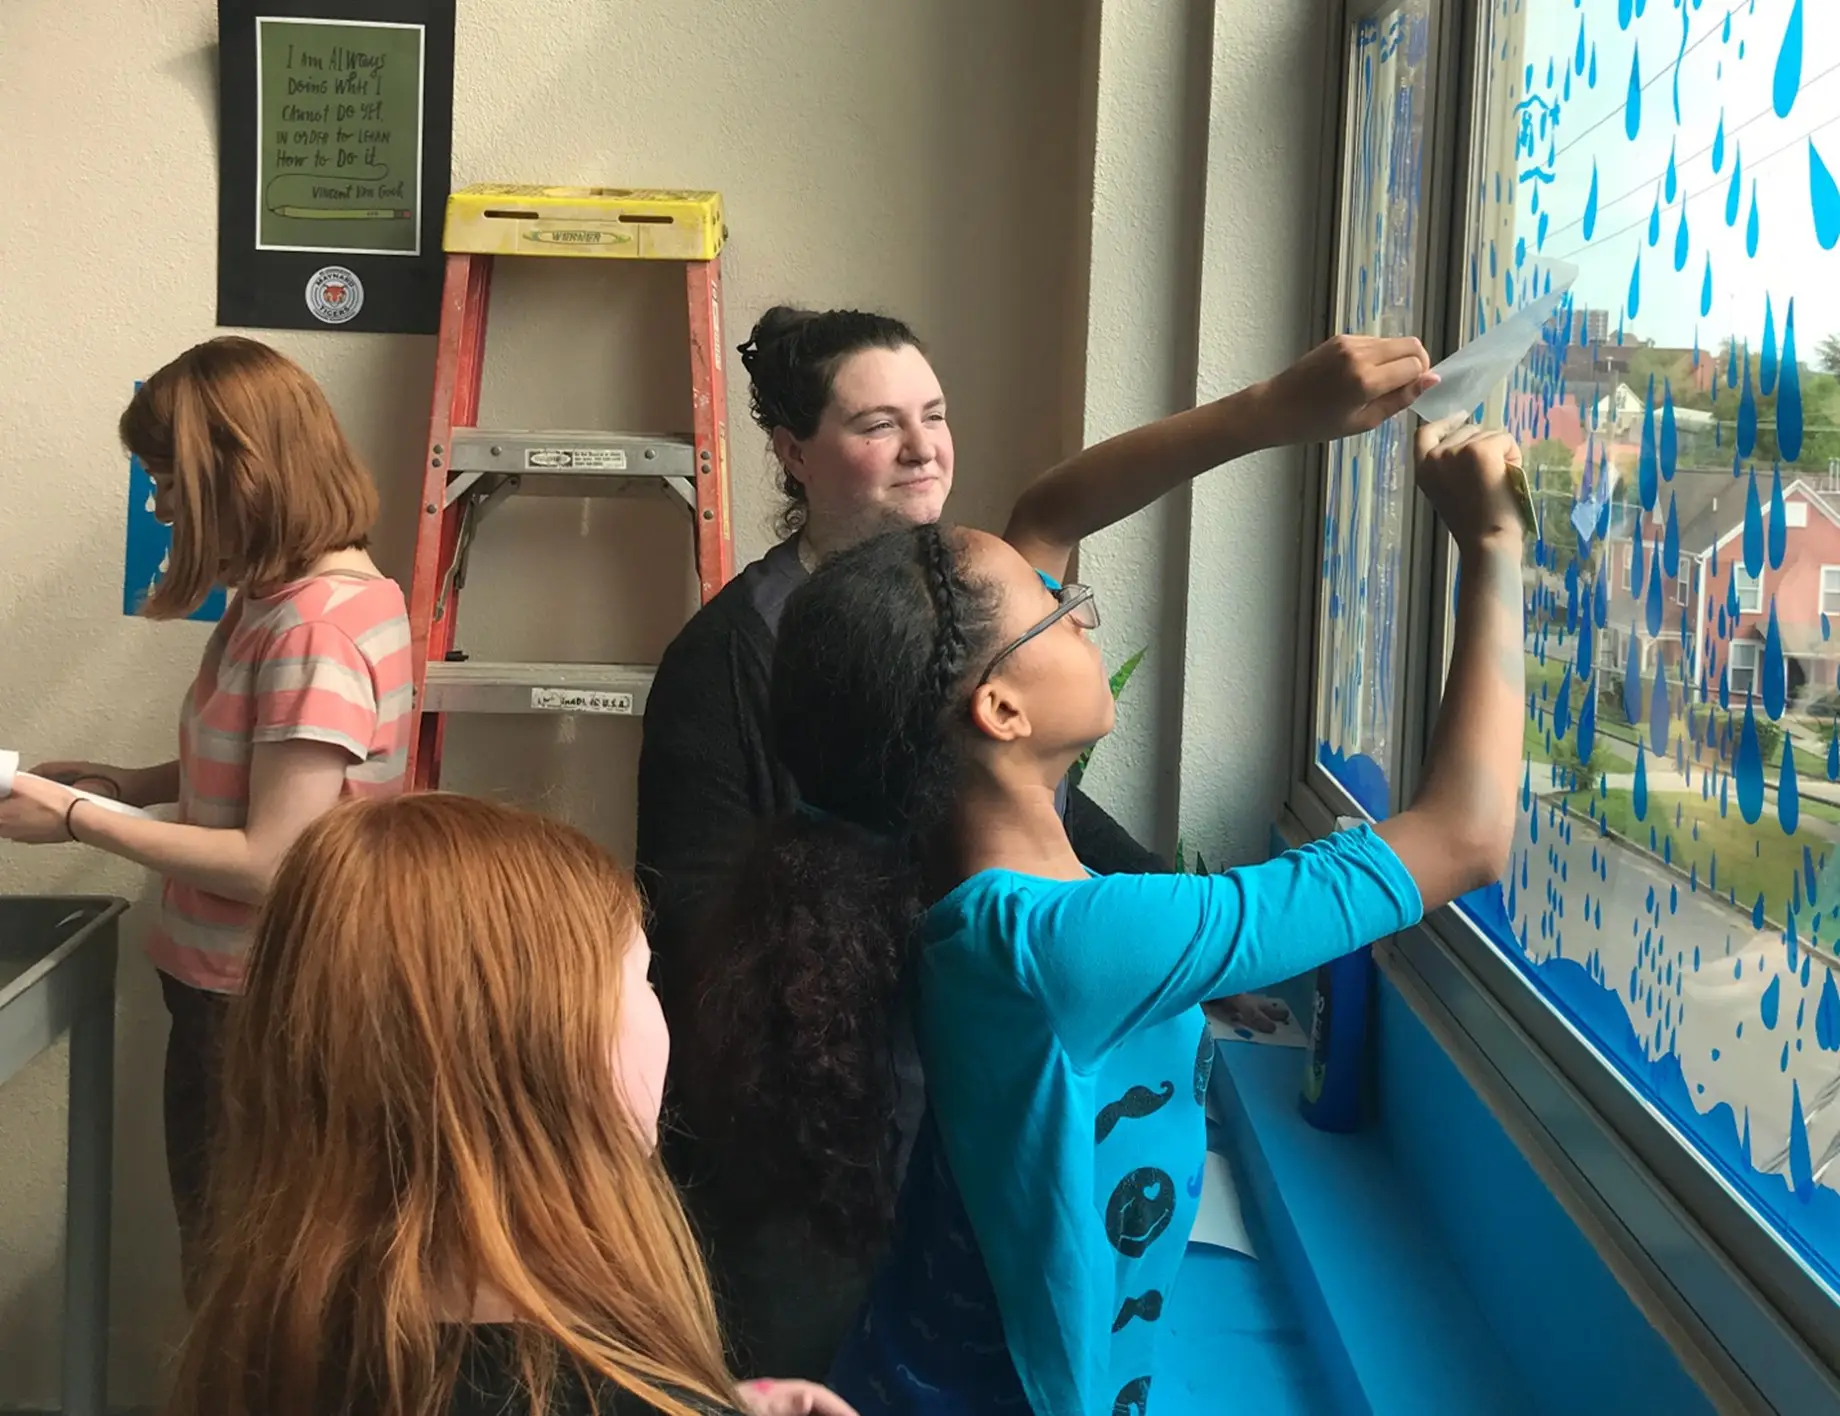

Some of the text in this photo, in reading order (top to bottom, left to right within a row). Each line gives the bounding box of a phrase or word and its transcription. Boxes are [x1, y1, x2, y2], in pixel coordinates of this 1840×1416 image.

[286, 44, 294, 69] I
[376, 75, 382, 95] I
[551, 230, 602, 243] WERNER
[315, 273, 355, 287] MAYNARD
[320, 305, 350, 317] TIGERS
